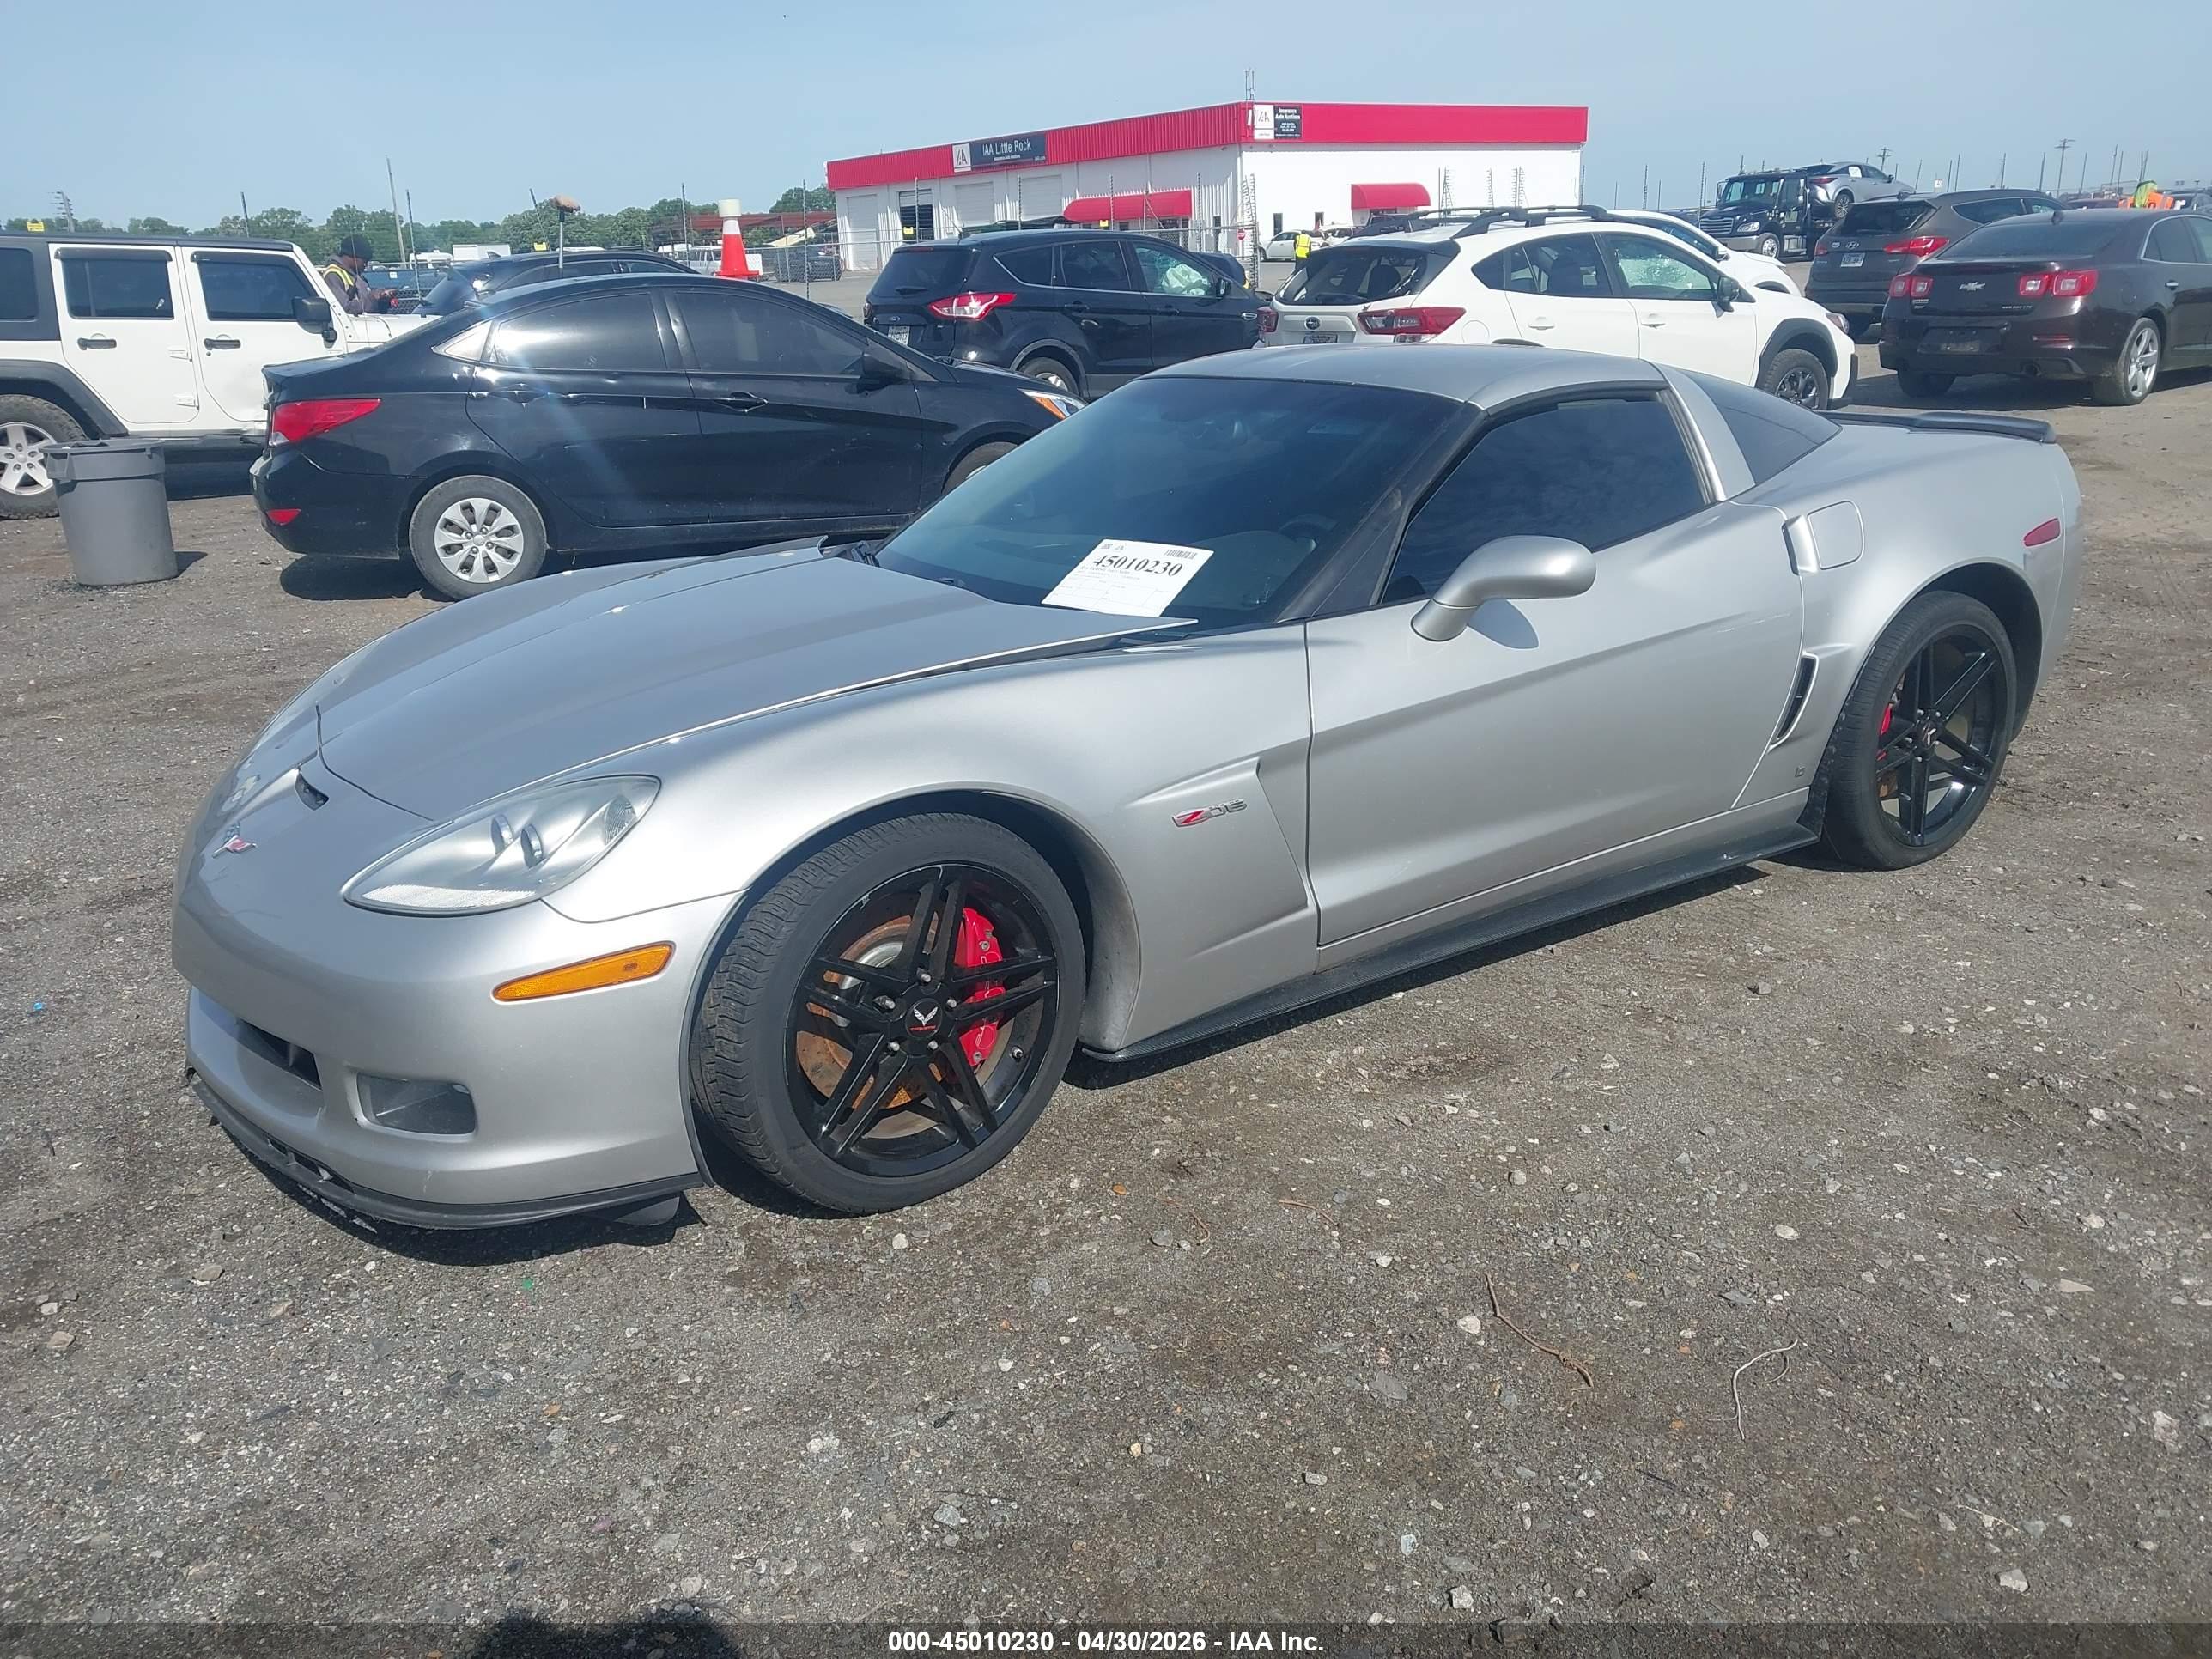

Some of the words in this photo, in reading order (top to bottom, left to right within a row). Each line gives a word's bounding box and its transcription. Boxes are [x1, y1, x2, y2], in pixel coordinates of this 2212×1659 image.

[982, 143, 994, 156] IAA
[995, 140, 1013, 155] Little
[1014, 138, 1032, 152] Rock
[1093, 554, 1183, 577] 45010230
[1172, 798, 1248, 827] Z06
